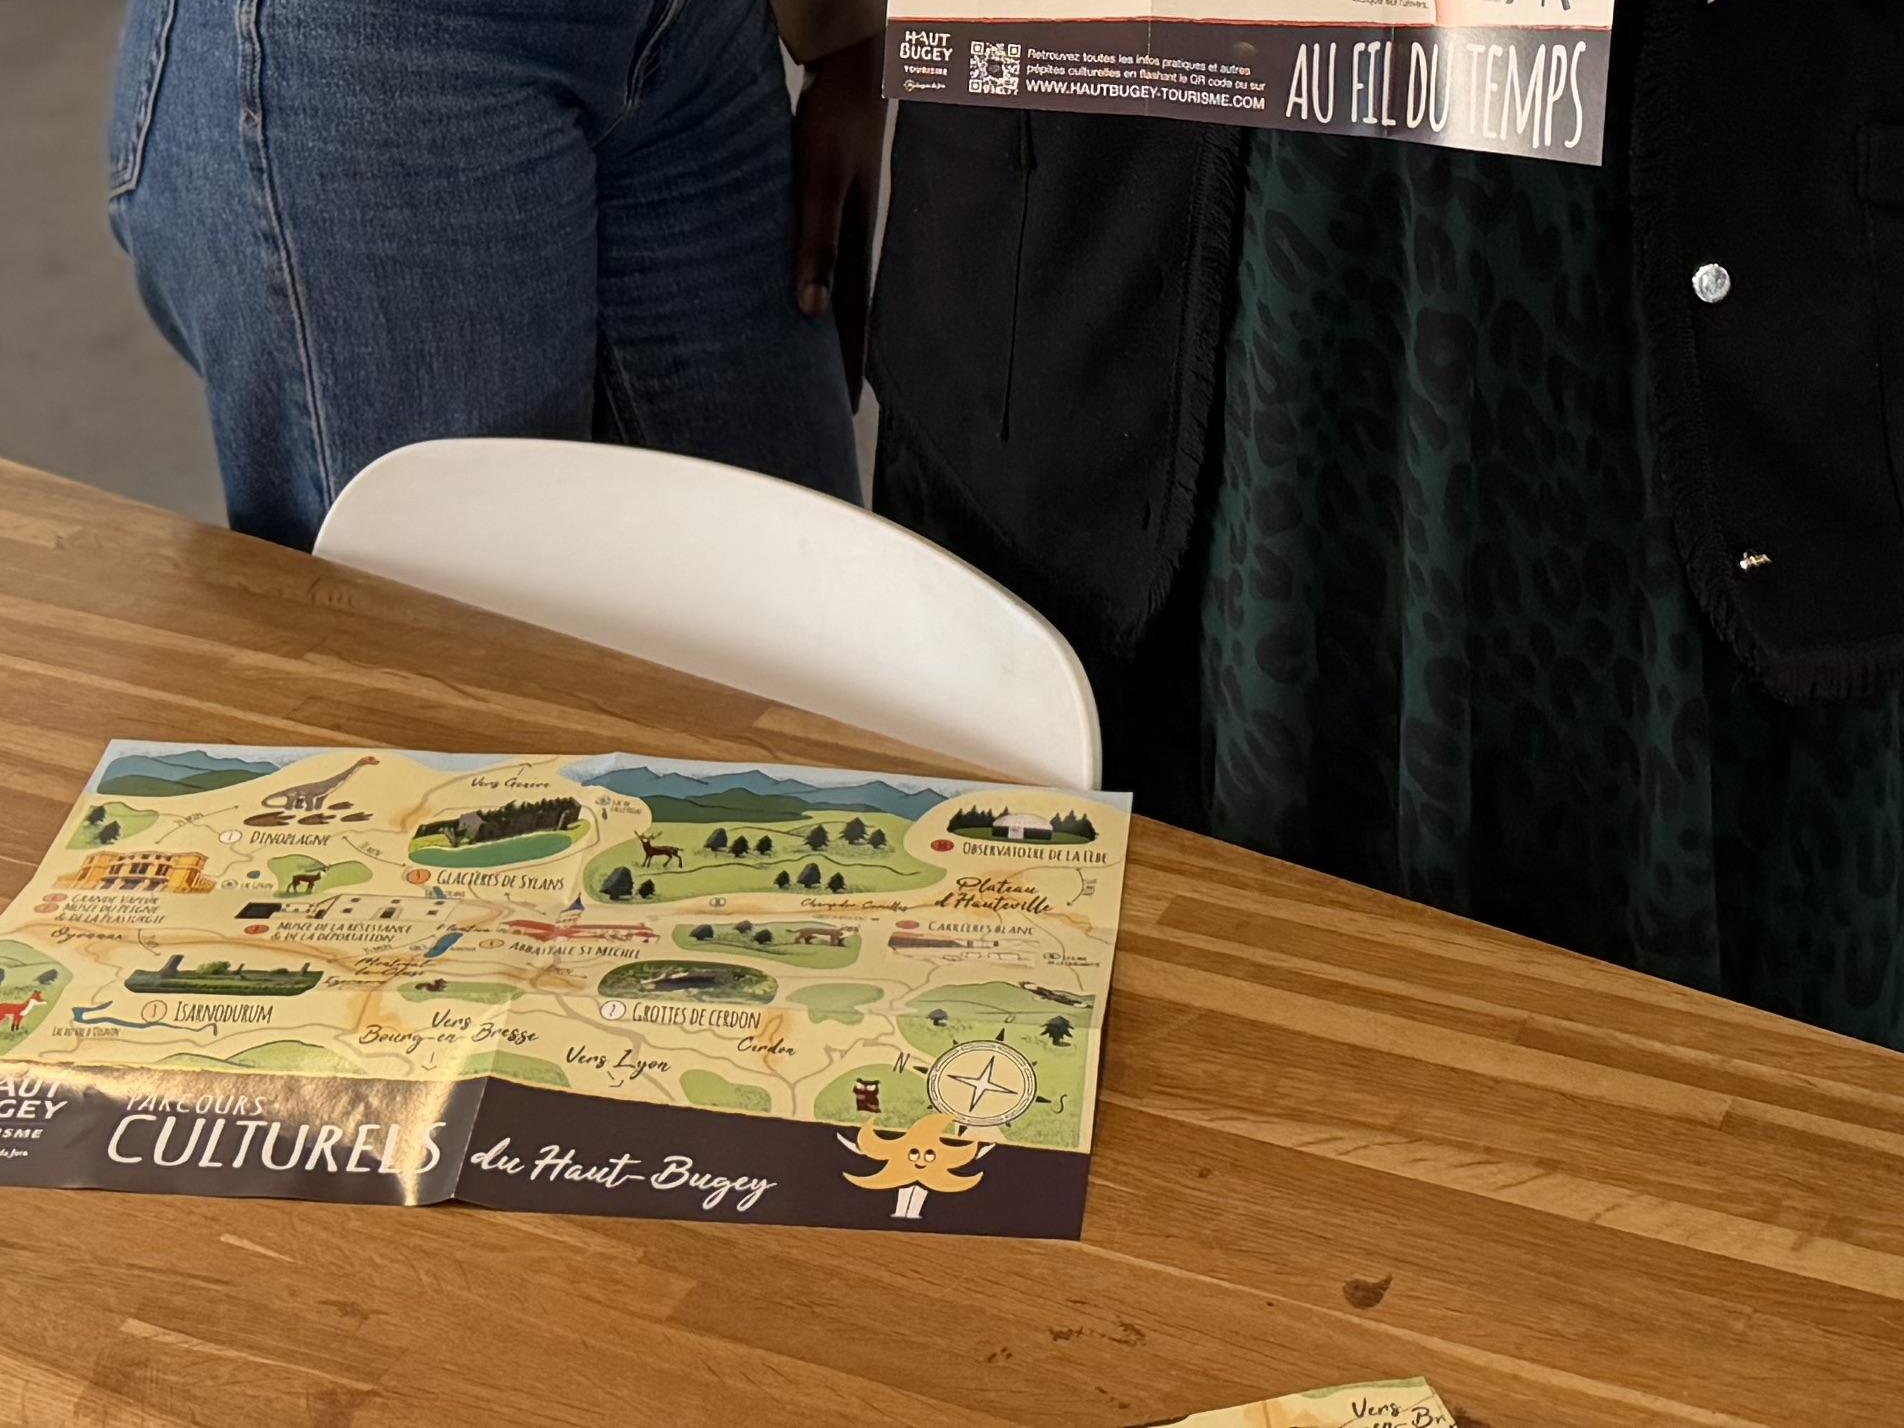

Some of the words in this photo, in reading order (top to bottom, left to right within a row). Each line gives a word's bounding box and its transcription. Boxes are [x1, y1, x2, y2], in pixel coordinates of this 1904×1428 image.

[899, 42, 953, 62] BUGEY
[904, 30, 952, 47] HAUT
[1285, 41, 1337, 125] AU
[1350, 40, 1397, 127] FIL
[1405, 41, 1453, 133] DU
[1464, 40, 1587, 150] TEMPS
[173, 999, 274, 1024] ISARNODURUM
[632, 1000, 686, 1026] GROTTES
[688, 1005, 706, 1026] DE
[707, 1005, 760, 1030] CERDON
[612, 1049, 672, 1079] Lyon
[892, 1051, 911, 1075] N
[105, 1112, 447, 1176] CULTURELS
[470, 1136, 525, 1175] du
[529, 1143, 778, 1212] Haut-Bugey
[1351, 1396, 1401, 1419] Vers
